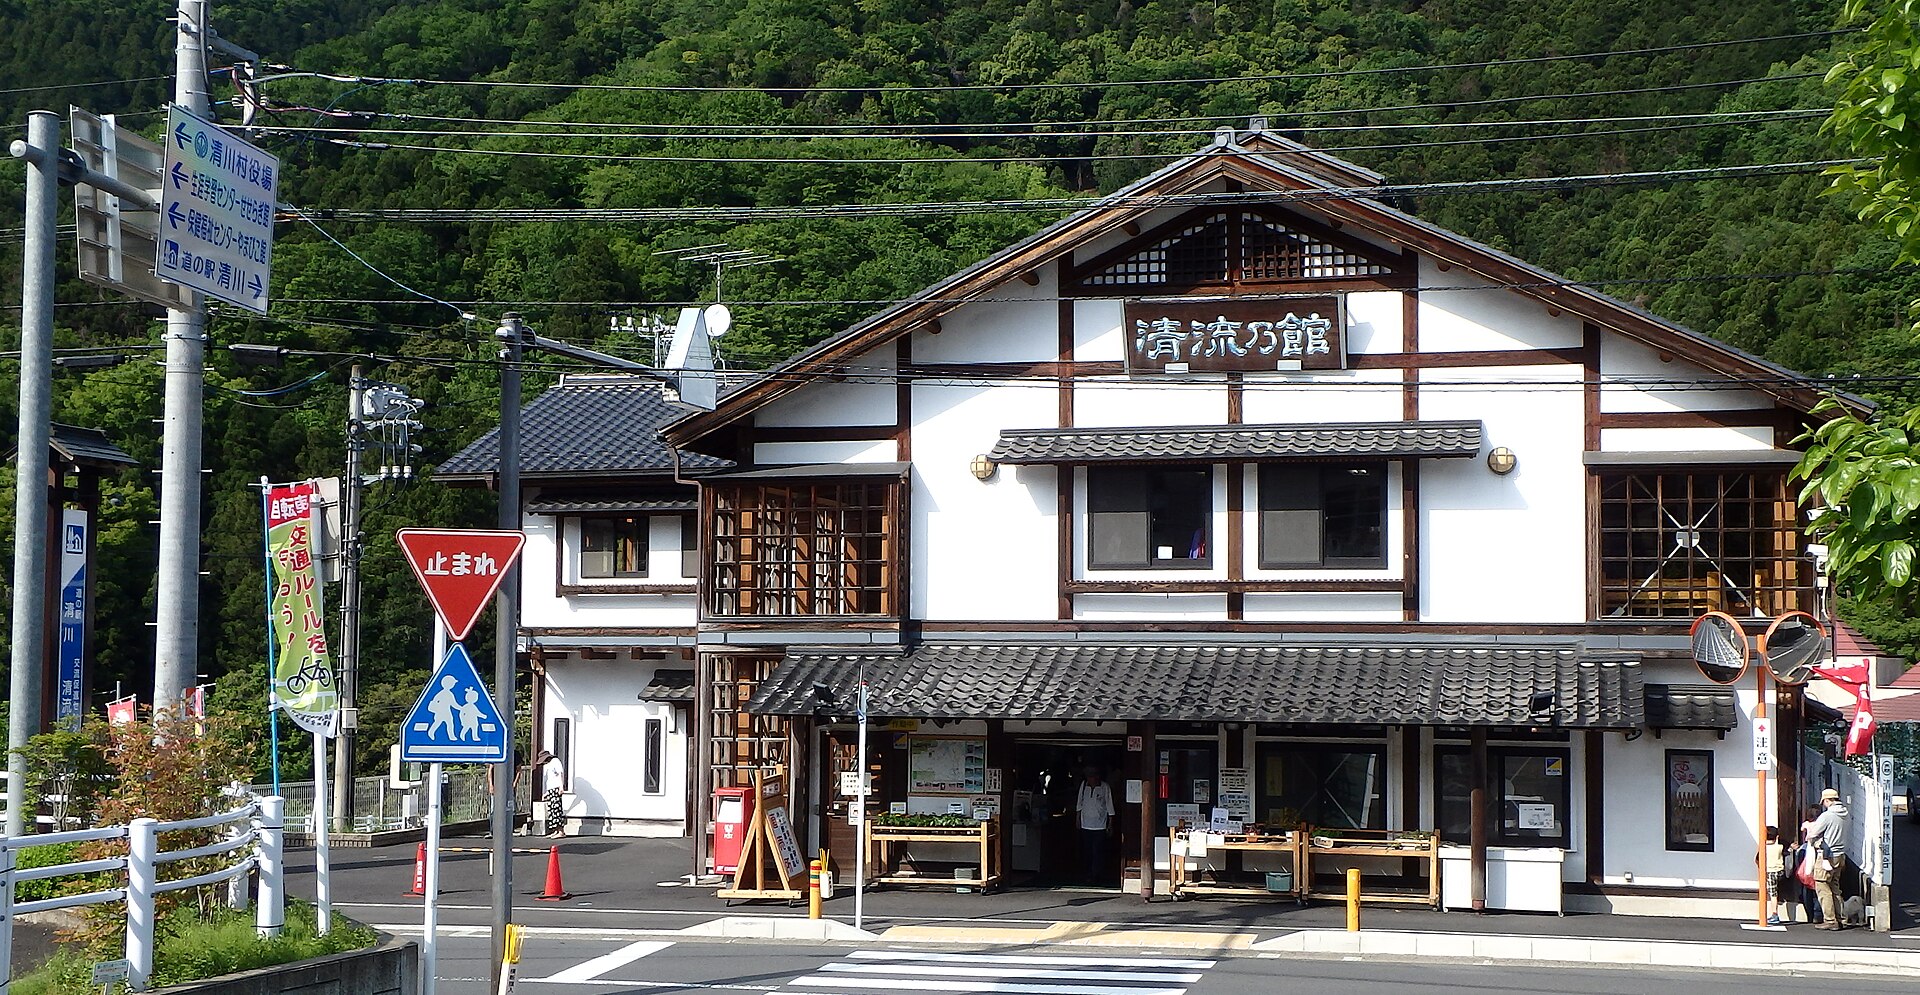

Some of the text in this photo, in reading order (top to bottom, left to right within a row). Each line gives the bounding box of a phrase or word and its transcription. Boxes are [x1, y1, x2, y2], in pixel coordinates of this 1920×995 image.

[209, 138, 273, 192] 清川村役場
[190, 169, 270, 228] 生涯学習センターせせらぎ館
[187, 208, 267, 265] 保健福祉センターやまびこ館
[181, 250, 246, 295] 道の駅 清川
[1135, 312, 1331, 361] 清流乃館
[270, 494, 309, 520] 自転車
[423, 551, 499, 576] 止まれ
[290, 525, 326, 654] 交通ルールを
[63, 602, 75, 643] 清川
[1756, 736, 1768, 765] 注意
